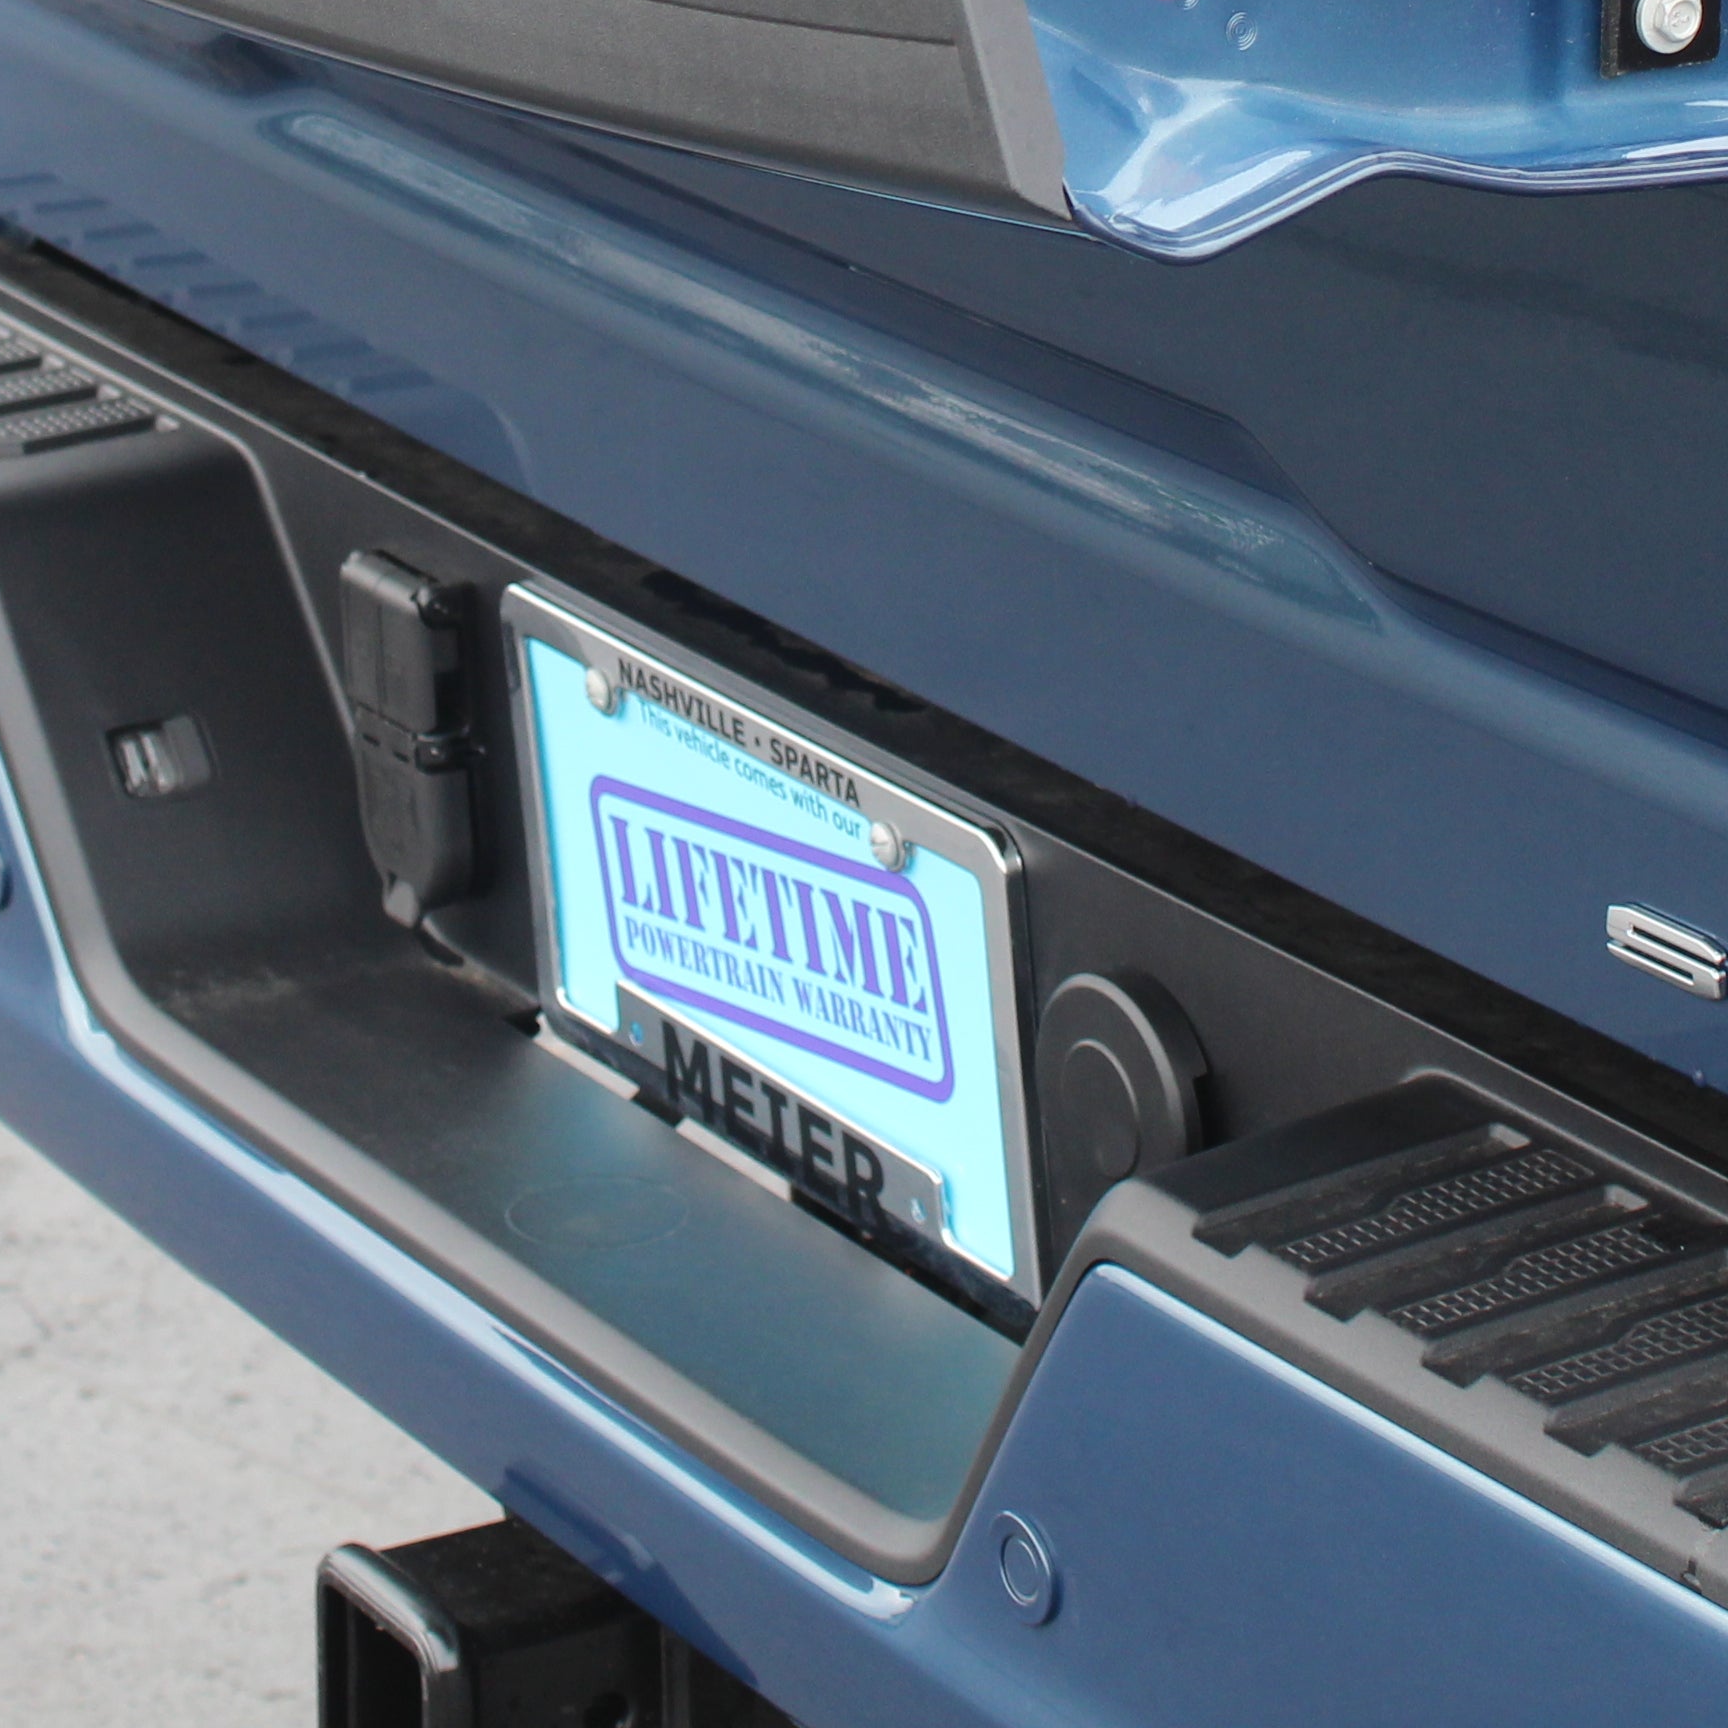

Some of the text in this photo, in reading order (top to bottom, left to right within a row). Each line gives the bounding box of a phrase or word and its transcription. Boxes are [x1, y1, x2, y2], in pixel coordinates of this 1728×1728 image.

[618, 657, 861, 809] NASHVILLE SPARTA
[639, 700, 861, 840] This vehicle comes with our
[608, 814, 929, 1016] LIFETIME
[623, 915, 933, 1063] POWERTRAIN WARRANTY
